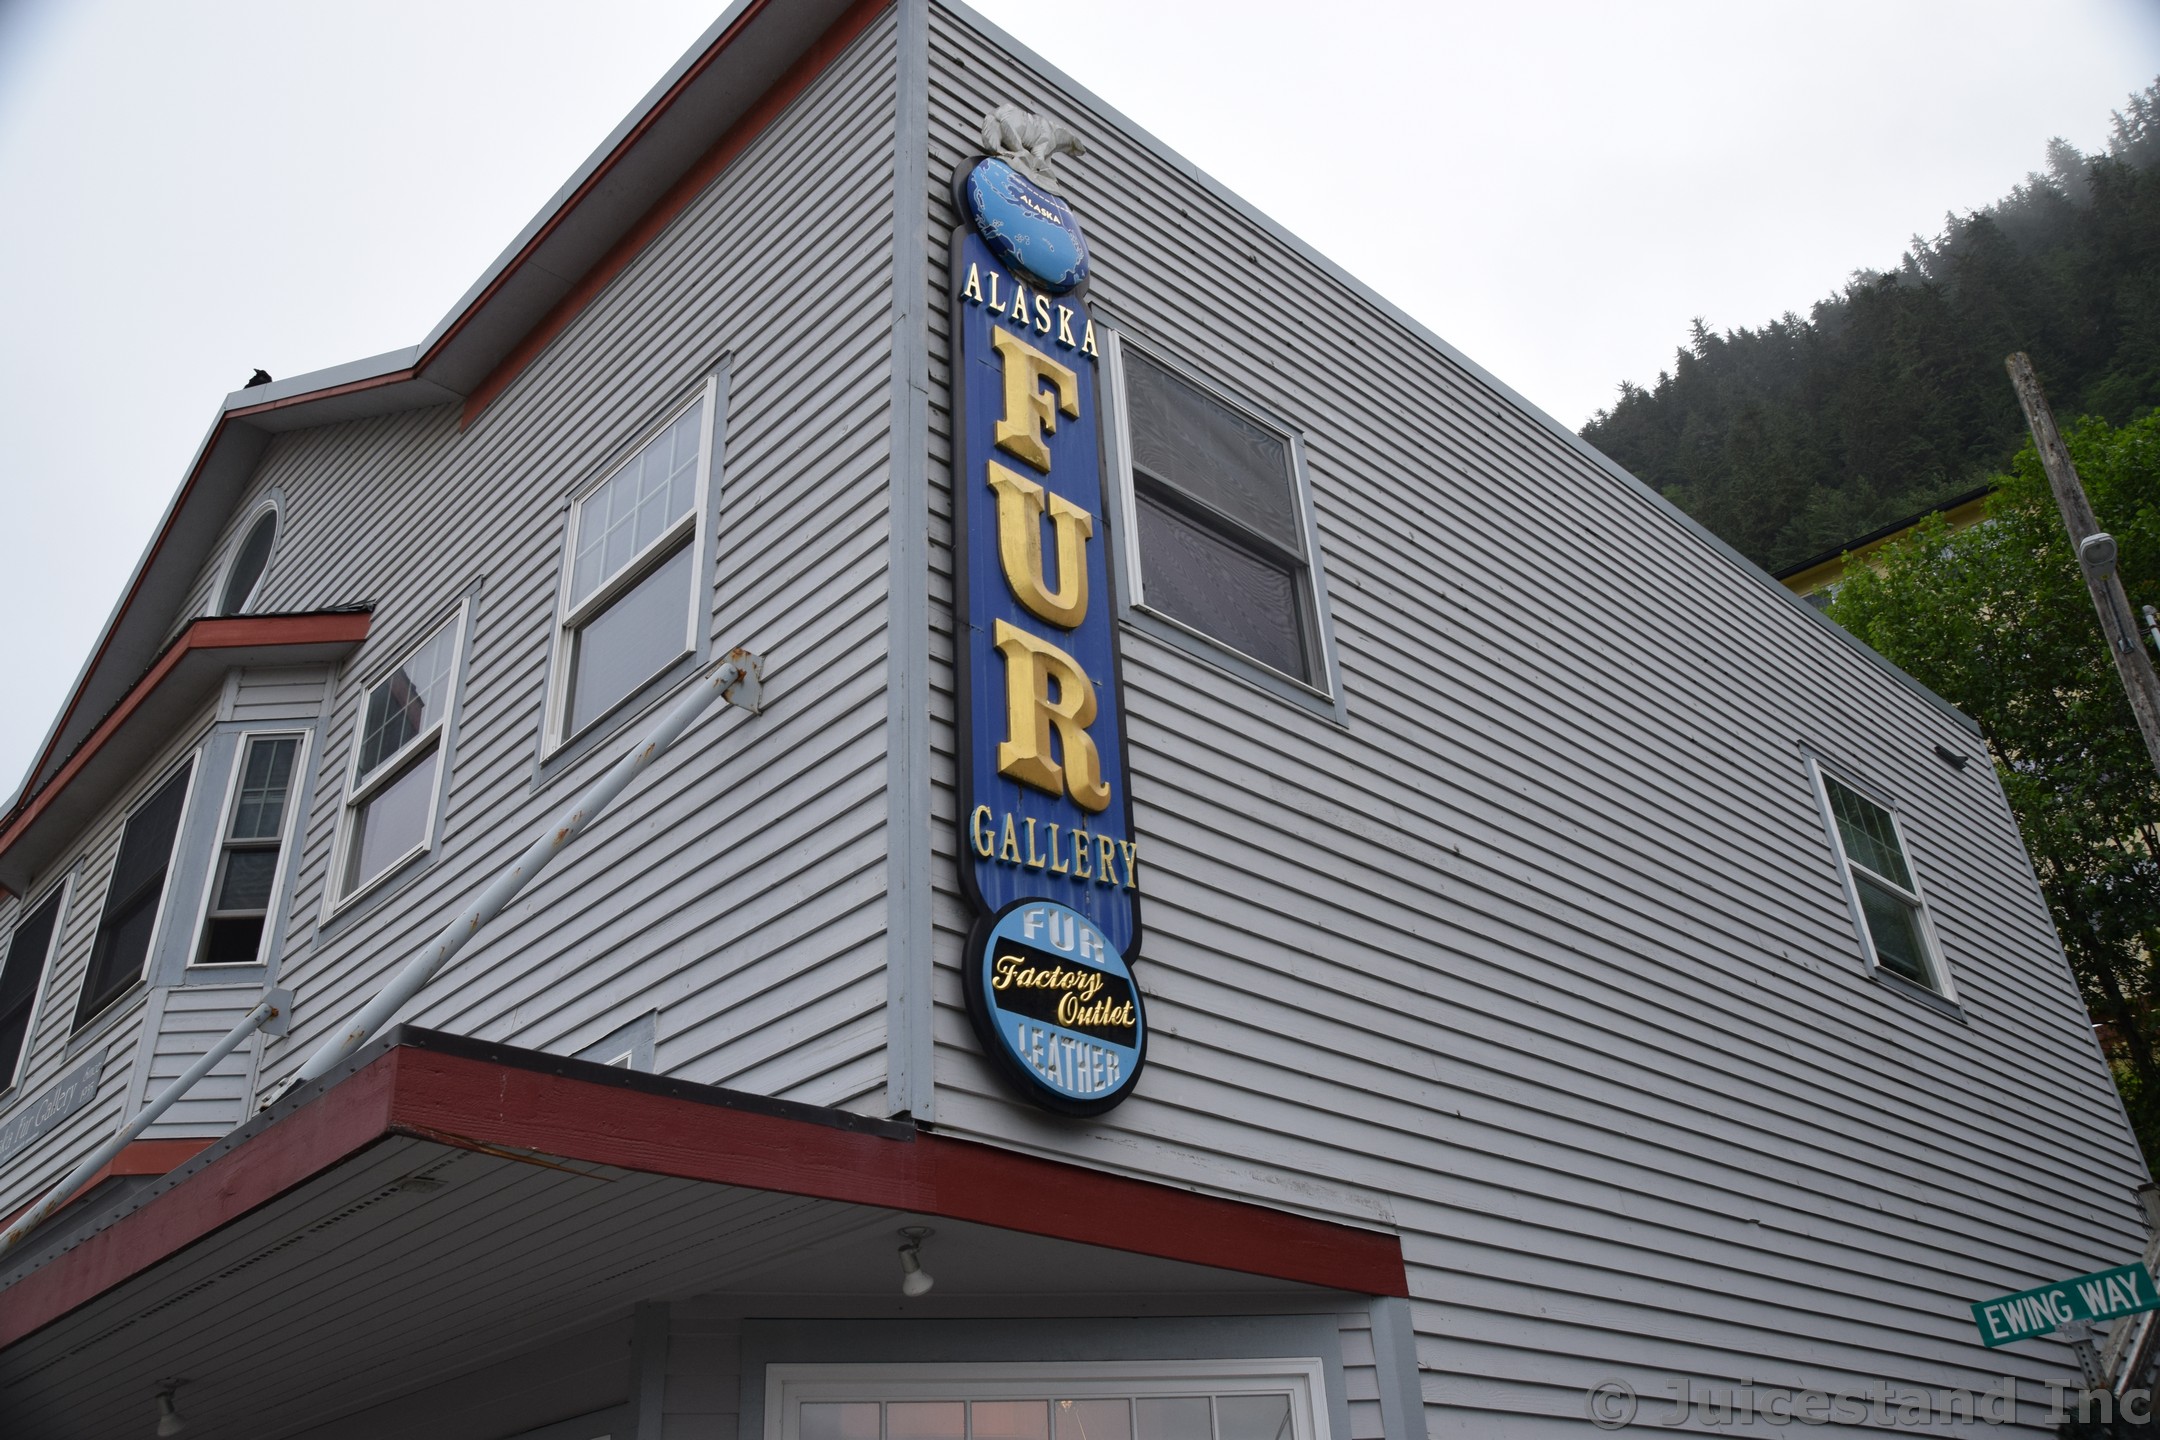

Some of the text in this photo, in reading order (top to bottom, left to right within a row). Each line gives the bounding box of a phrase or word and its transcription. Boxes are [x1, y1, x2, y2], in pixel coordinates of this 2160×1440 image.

[1020, 195, 1061, 225] ALASKA
[962, 262, 1099, 358] ALASKA
[986, 324, 1111, 813] FUR
[970, 805, 1138, 889] GALLERY
[1023, 906, 1105, 964] FUR
[992, 955, 1103, 1001] Factory
[1057, 991, 1136, 1028] Outlet
[1018, 1023, 1121, 1093] LEATHER
[35, 1083, 78, 1127] Gallery
[1983, 1271, 2143, 1339] EWING WAY
